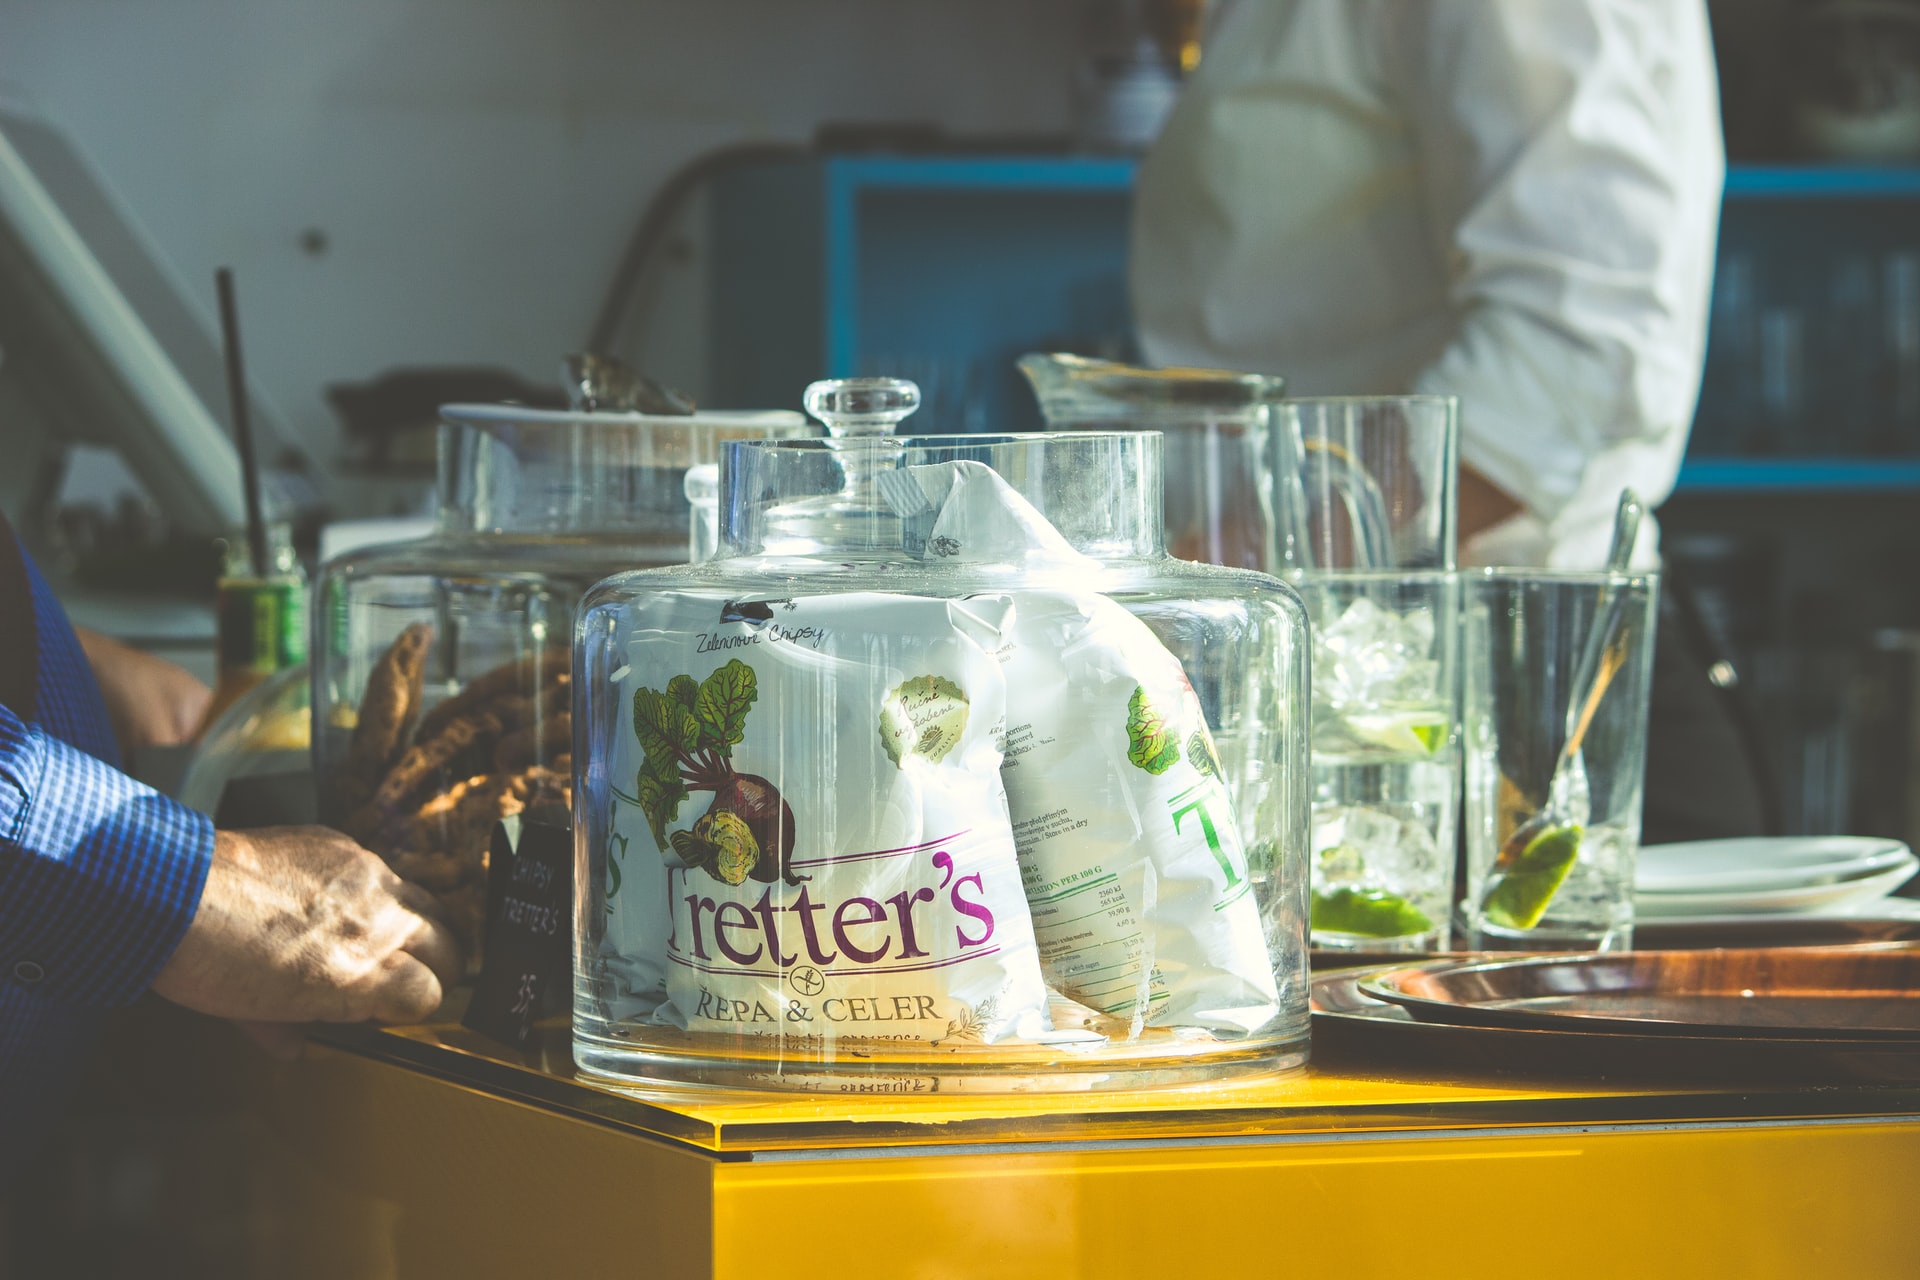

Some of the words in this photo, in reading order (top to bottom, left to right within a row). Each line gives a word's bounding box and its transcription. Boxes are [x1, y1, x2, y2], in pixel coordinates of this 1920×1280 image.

[769, 624, 825, 649] Chipsy
[1045, 829, 1062, 839] Store
[1076, 818, 1089, 828] dry
[1060, 874, 1079, 886] PER
[1079, 869, 1094, 879] 100
[1094, 865, 1103, 874] G
[1098, 887, 1114, 898] 2360
[1112, 893, 1126, 904] kcal
[502, 895, 560, 936] TRETTER'S
[667, 851, 995, 968] Tretter's
[694, 985, 777, 1023] ŘEPA
[786, 999, 814, 1023] &
[822, 995, 943, 1023] CELER
